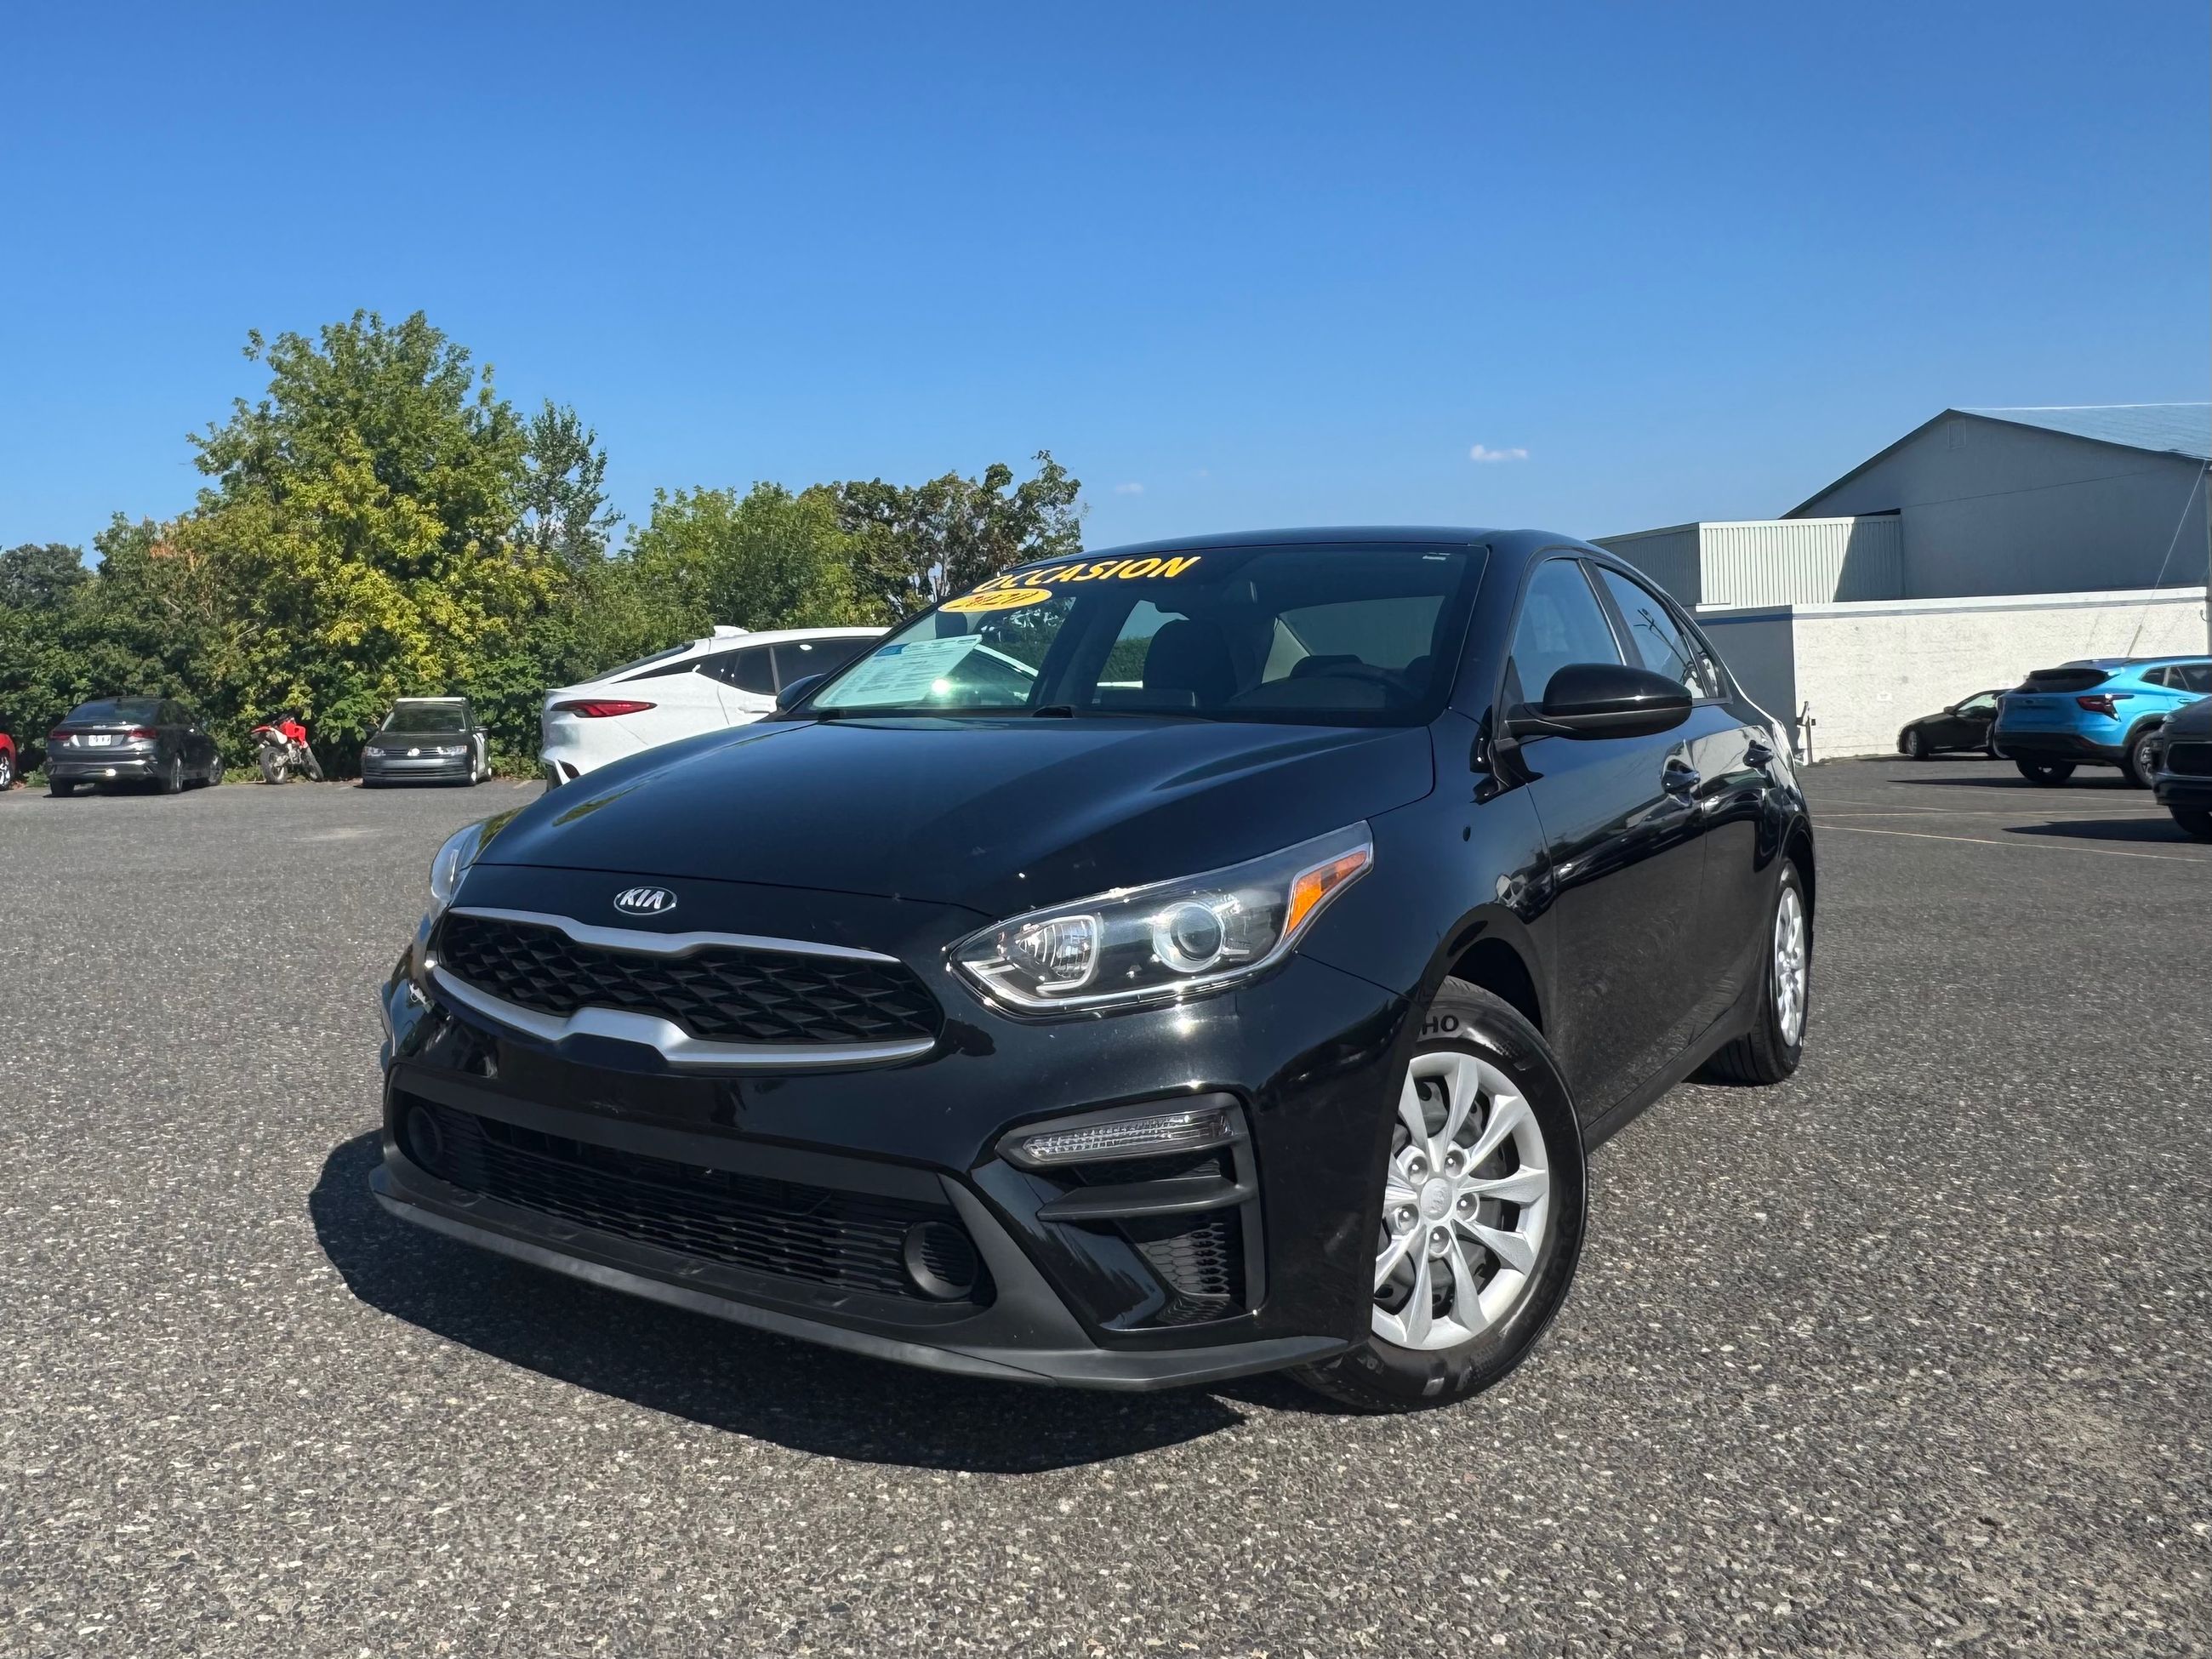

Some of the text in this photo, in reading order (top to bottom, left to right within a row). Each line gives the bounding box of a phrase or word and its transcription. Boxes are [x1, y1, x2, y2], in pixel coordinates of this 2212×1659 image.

[972, 556, 1201, 594] OCCASION
[619, 888, 665, 909] KIA
[1417, 1014, 1460, 1036] HO
